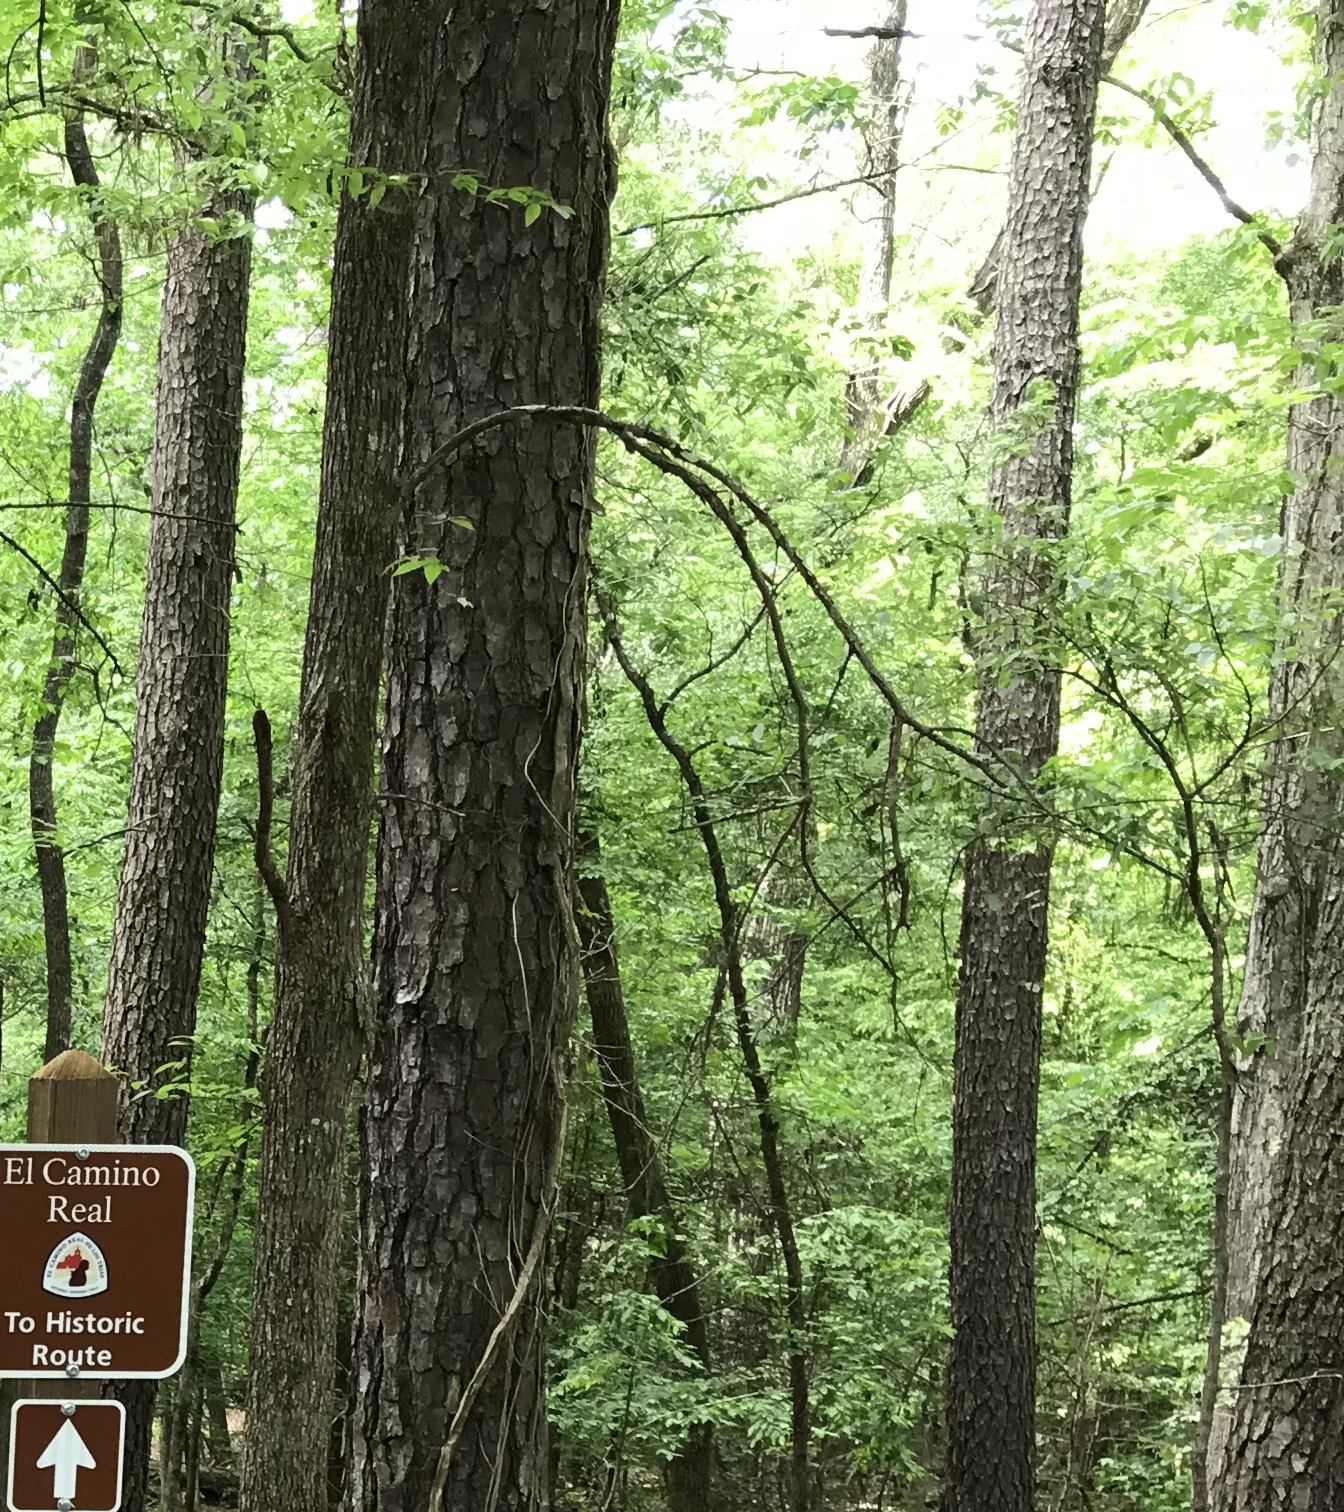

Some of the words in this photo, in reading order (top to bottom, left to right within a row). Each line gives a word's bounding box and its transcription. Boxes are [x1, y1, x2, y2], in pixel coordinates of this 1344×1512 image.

[3, 1157, 33, 1185] El
[42, 1157, 160, 1187] Camino
[47, 1195, 112, 1223] Real
[4, 1311, 36, 1334] To
[45, 1310, 145, 1334] Historic
[32, 1344, 112, 1367] Route
